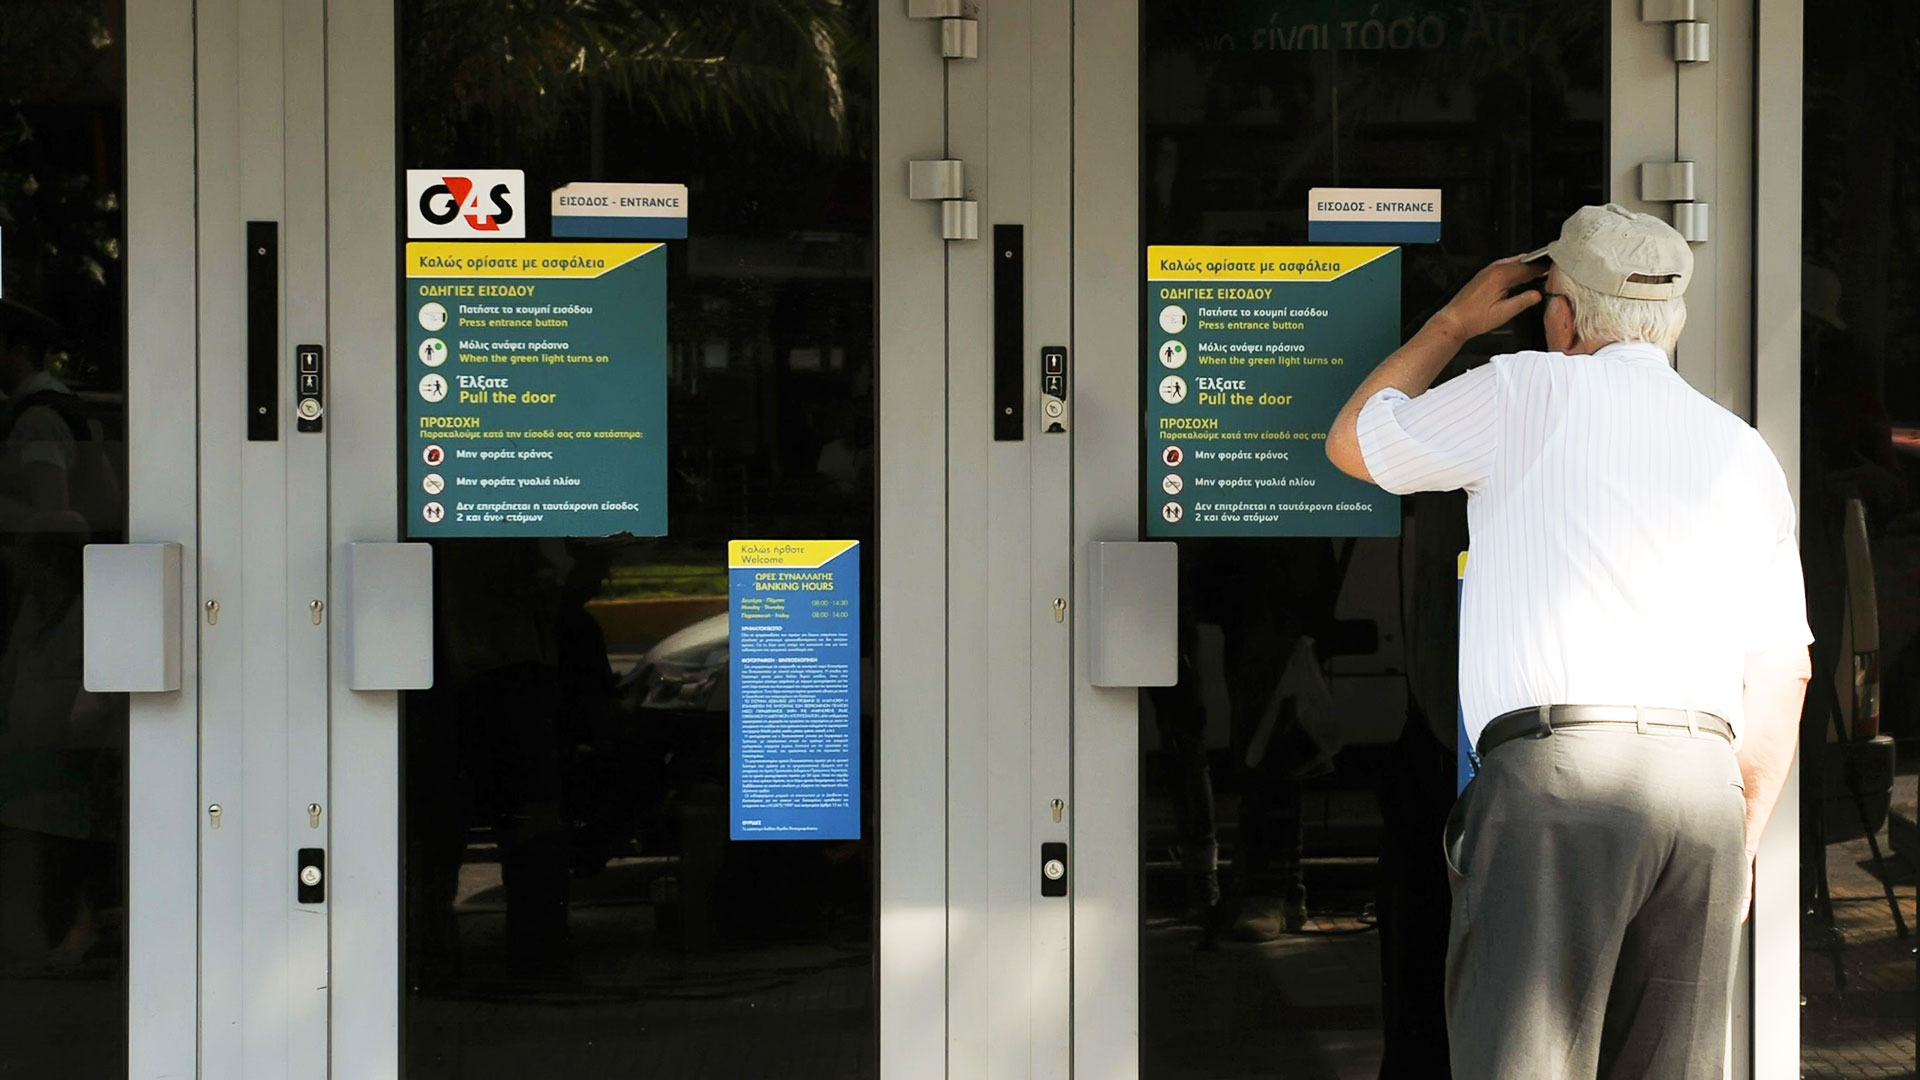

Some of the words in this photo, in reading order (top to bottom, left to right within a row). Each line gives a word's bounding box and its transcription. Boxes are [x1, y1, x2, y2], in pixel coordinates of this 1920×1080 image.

[419, 176, 513, 231] G4S
[560, 196, 608, 206] ΕΙΣΟΔΟΣ
[620, 198, 679, 207] ENTRANCE
[1318, 202, 1365, 211] ΕΙΣΟΔΟΣ
[1376, 202, 1434, 212] ENTRANCE
[420, 255, 462, 270] Καλώς
[467, 255, 518, 271] ορίσατε
[522, 259, 538, 271] με
[542, 256, 604, 271] ασφάλεια
[1161, 258, 1202, 273] Καλώς
[1260, 262, 1274, 274] με
[1279, 259, 1340, 274] ασφάλεια
[419, 285, 475, 296] ΟΔΗΓΙΕΣ
[478, 285, 535, 296] ΕΙΣΟΔΟΥ
[1160, 288, 1214, 299] ΟΔΗΓΙΕΣ
[1218, 288, 1272, 299] ΕΙΣΟΔΟΥ
[459, 304, 500, 314] Πατήστε
[516, 304, 550, 316] κουμπί
[553, 304, 592, 314] εισόδου
[1199, 307, 1238, 316] Πατήστε
[1254, 307, 1287, 318] κουμπί
[1290, 307, 1328, 316] εισόδου
[459, 318, 486, 327] Press
[489, 319, 532, 327] entrance
[535, 318, 568, 327] button
[1199, 320, 1225, 329] Press
[1227, 322, 1270, 330] entrance
[1272, 321, 1304, 329] button
[459, 340, 489, 351] Μόλις
[492, 340, 526, 351] ανάψει
[528, 340, 569, 351] πράσινο
[1199, 342, 1227, 353] Μόλις
[1230, 342, 1262, 354] ανάψει
[1266, 342, 1305, 354] πράσινο
[459, 354, 488, 362] When
[491, 354, 508, 362] the
[510, 356, 539, 365] green
[542, 354, 564, 364] light
[567, 355, 593, 363] turns
[1198, 356, 1226, 364] When
[1229, 356, 1245, 364] the
[1248, 358, 1275, 367] green
[1278, 356, 1300, 367] light
[456, 375, 508, 390] Έλξατε
[1195, 377, 1246, 392] Έλξατε
[460, 391, 488, 403] Pull
[492, 391, 516, 403] the
[521, 391, 556, 403] door
[1199, 393, 1226, 405] Pull
[1230, 393, 1254, 405] the
[1259, 393, 1292, 405] door
[420, 417, 480, 428] ΠΡΟΣΟΧΗ
[1160, 418, 1218, 429] ΠΡΟΣΟΧΗ
[420, 429, 481, 440] Παρακαλούμε
[483, 430, 504, 438] κατά
[524, 429, 554, 438] είσοδό
[1160, 430, 1219, 441] Παρακαλούμε
[1221, 430, 1241, 439] κατά
[1261, 431, 1290, 439] είσοδό
[456, 450, 478, 458] Μην
[480, 449, 516, 460] φοράτε
[518, 449, 553, 460] κράνος
[1195, 451, 1216, 459] Μην
[1218, 450, 1252, 461] φοράτε
[1255, 450, 1288, 461] κράνος
[456, 477, 478, 485] Μην
[480, 476, 516, 488] φοράτε
[518, 476, 550, 488] γυαλιά
[553, 476, 580, 485] ηλίου
[1195, 478, 1216, 486] Μην
[1218, 477, 1252, 488] φοράτε
[1254, 477, 1286, 488] γυαλιά
[1289, 477, 1315, 486] ηλίου
[456, 502, 474, 510] Δεν
[476, 501, 531, 512] επιτρέπεται
[542, 501, 598, 512] ταυτόχρονη
[601, 501, 639, 511] είσοδος
[1195, 502, 1212, 510] Δεν
[1214, 502, 1267, 513] επιτρέπεται
[1278, 502, 1333, 512] ταυτόχρονη
[1336, 502, 1372, 512] είσοδος
[456, 513, 463, 521] 2
[1195, 513, 1201, 521] 2
[1221, 513, 1240, 521] άνω
[1243, 513, 1279, 523] ατόμων
[741, 555, 783, 563] Welcome
[755, 582, 799, 591] BANKING
[802, 582, 833, 590] HOURS
